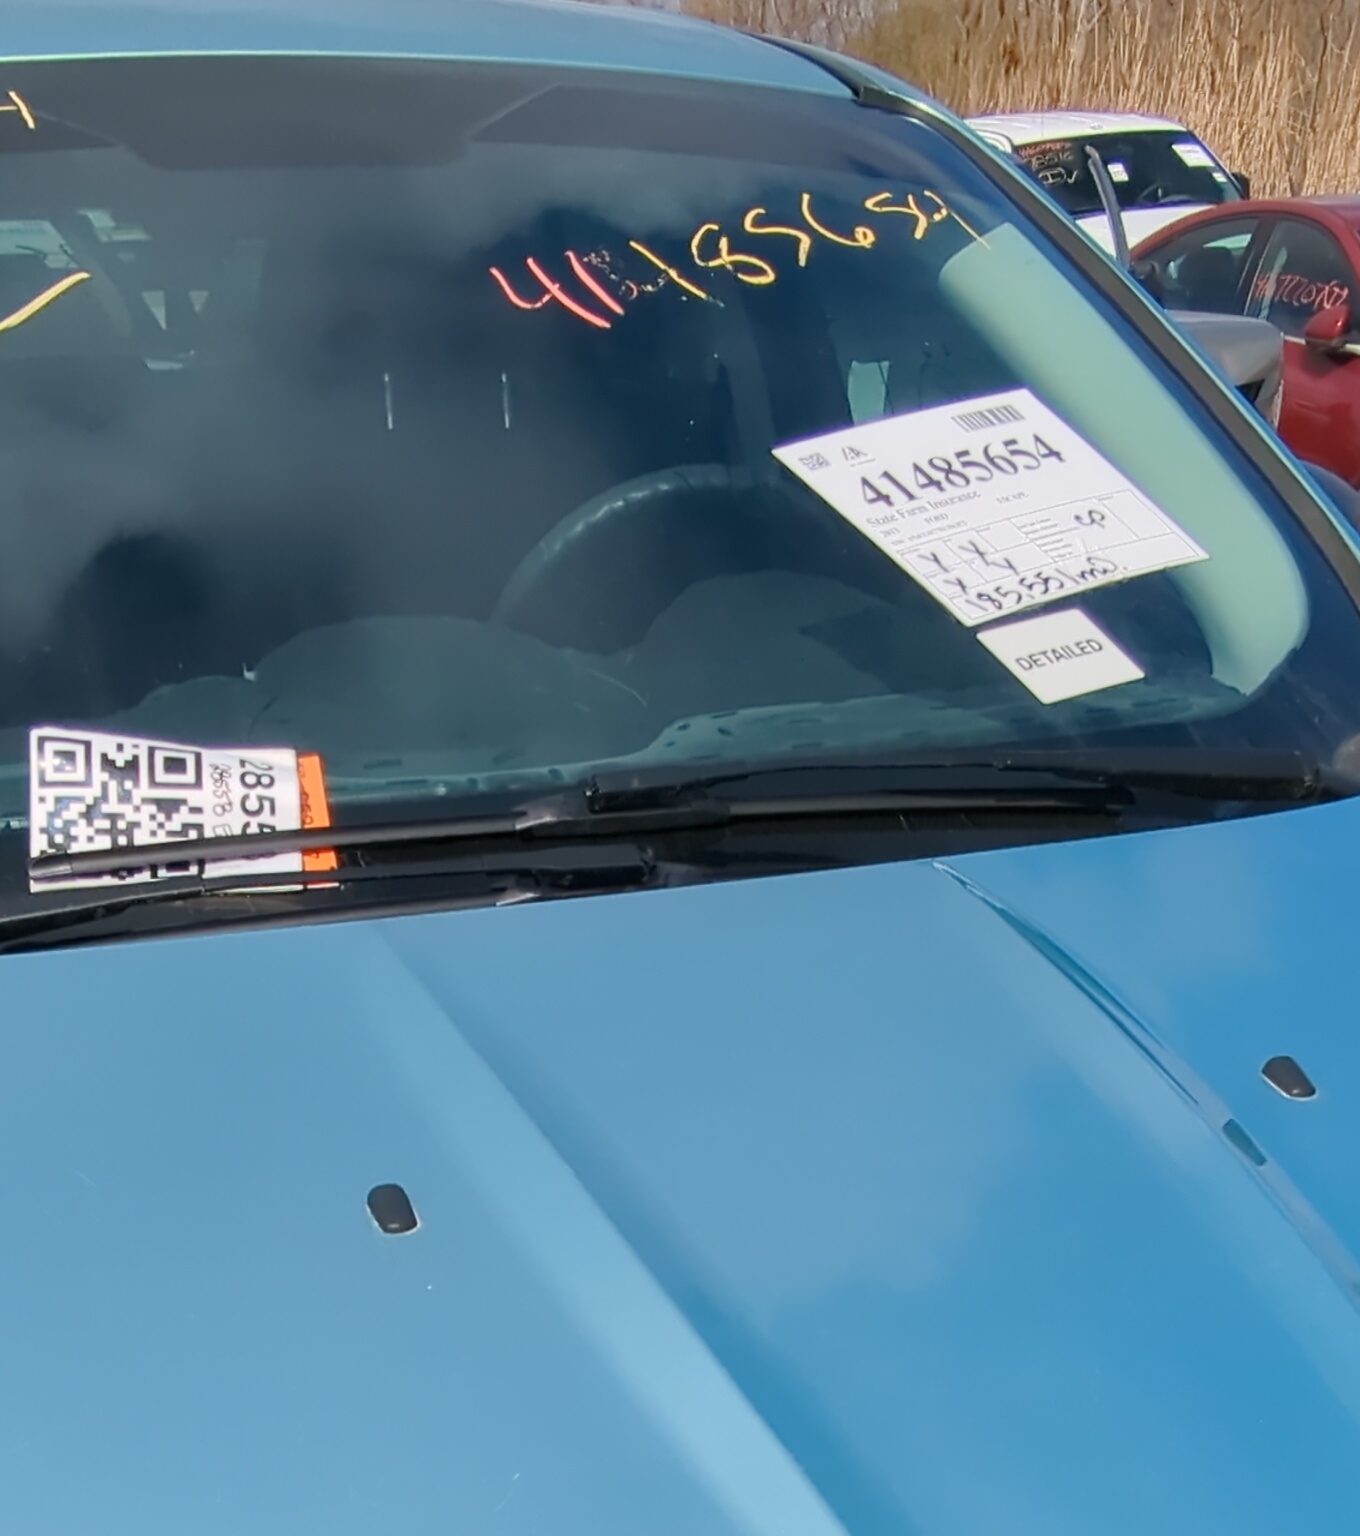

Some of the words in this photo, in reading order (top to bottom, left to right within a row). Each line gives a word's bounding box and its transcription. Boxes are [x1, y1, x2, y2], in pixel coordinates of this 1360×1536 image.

[860, 433, 1066, 508] 41485654
[866, 512, 897, 528] State
[896, 503, 930, 519] Farm
[927, 490, 982, 510] Insurance
[1015, 638, 1104, 672] DETAILED
